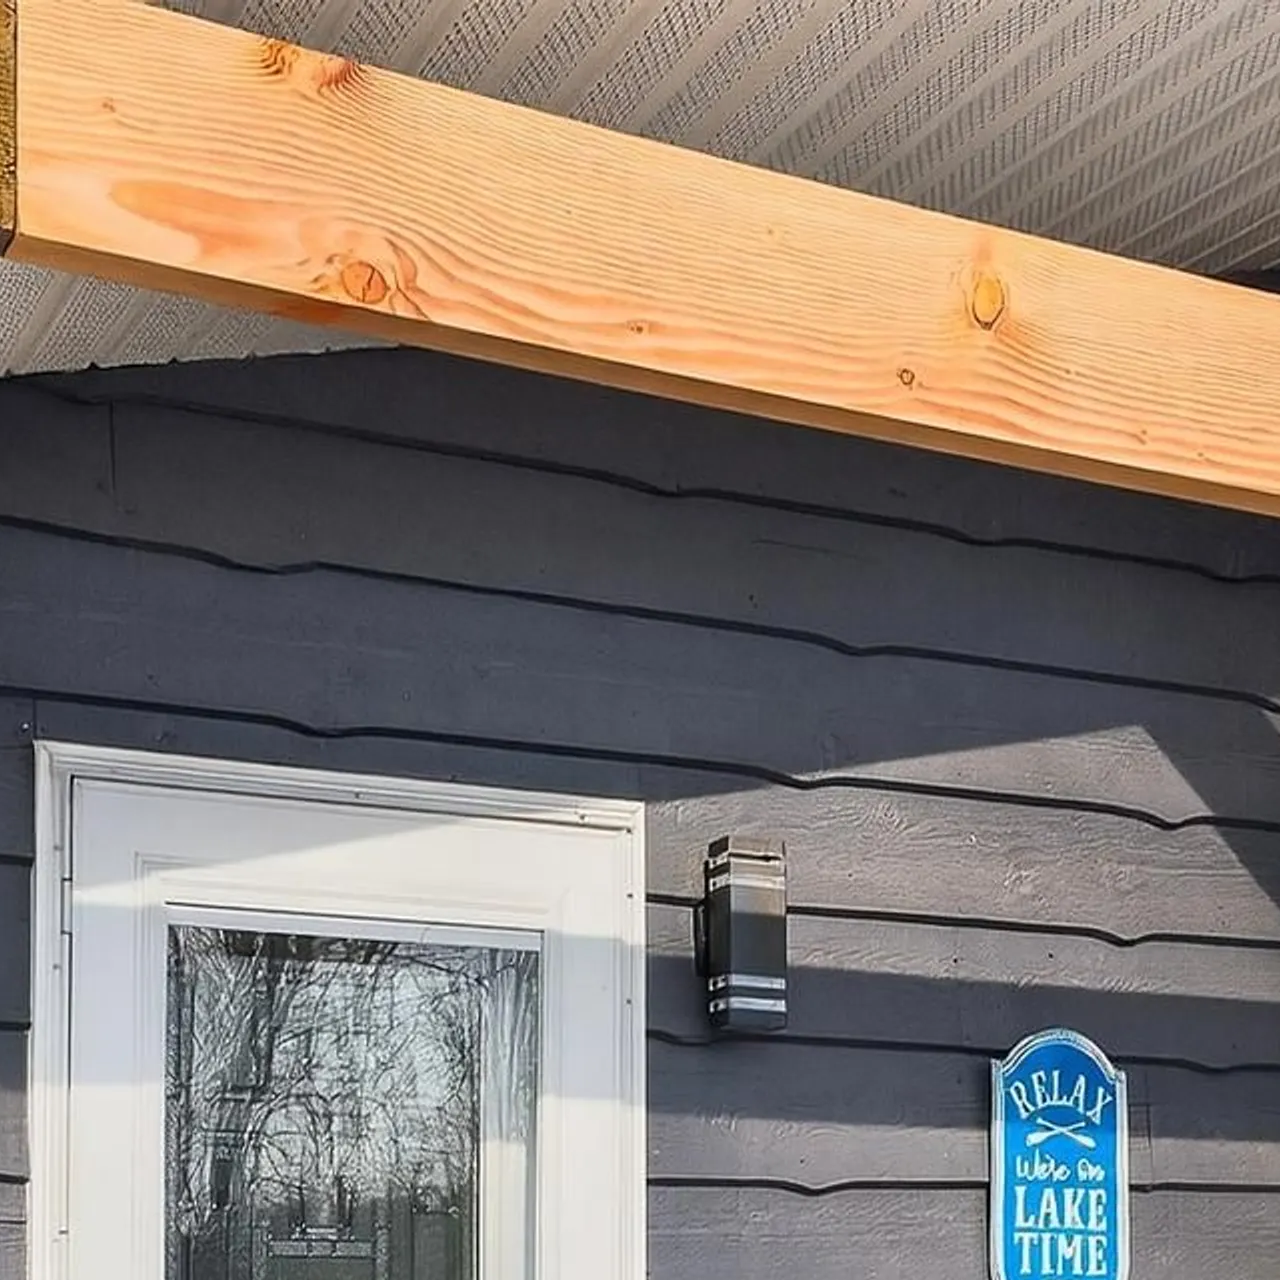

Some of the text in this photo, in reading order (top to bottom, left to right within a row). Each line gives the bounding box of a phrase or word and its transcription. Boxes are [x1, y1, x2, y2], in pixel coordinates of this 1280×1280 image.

[1009, 1070, 1113, 1125] RELAX
[1014, 1185, 1107, 1232] LAKE
[1014, 1231, 1108, 1277] TIME
